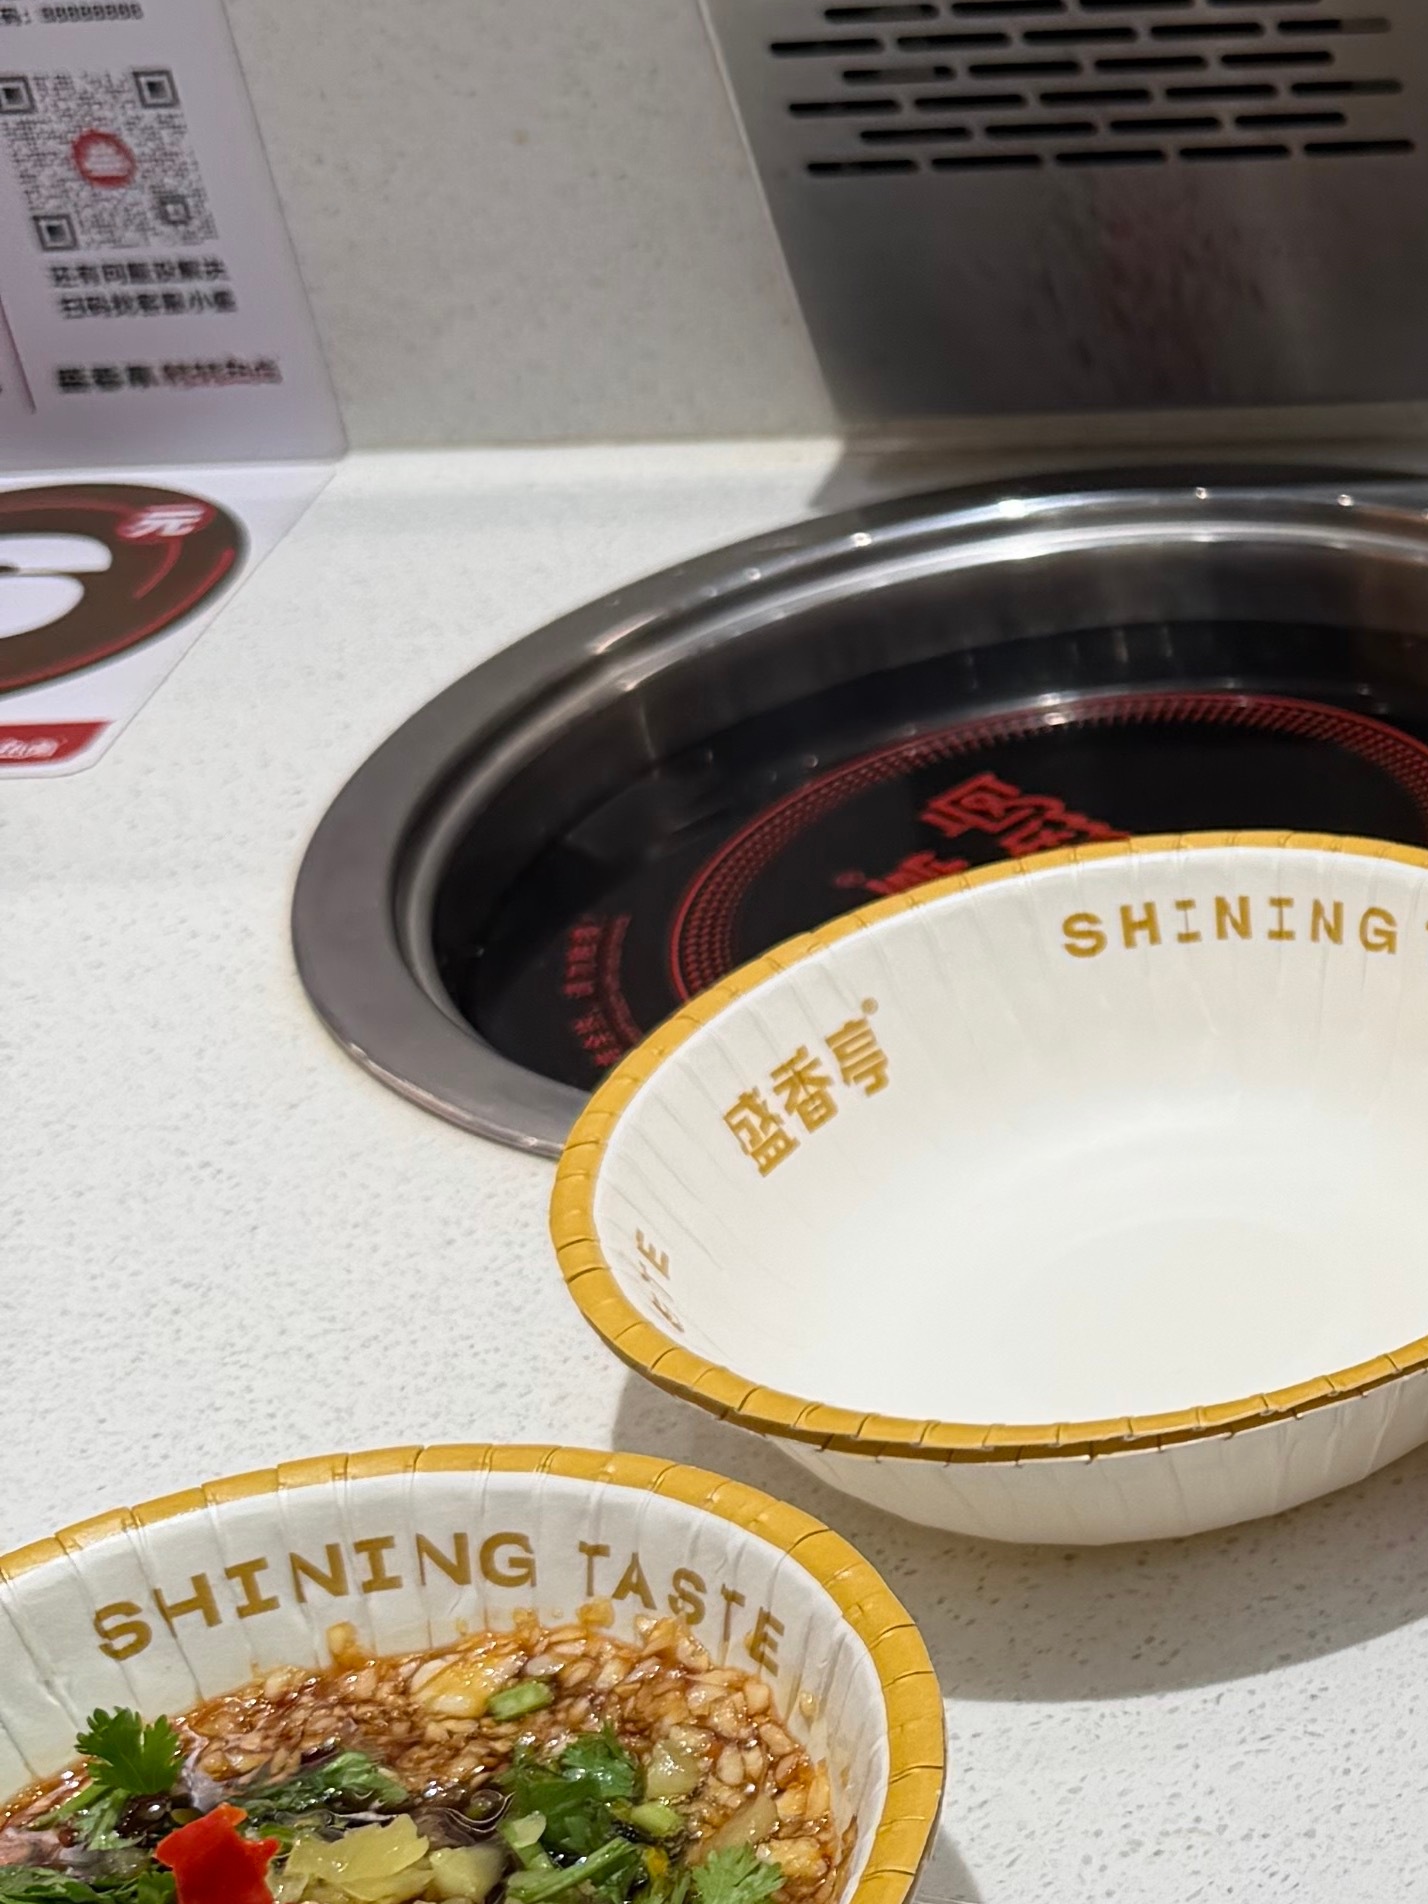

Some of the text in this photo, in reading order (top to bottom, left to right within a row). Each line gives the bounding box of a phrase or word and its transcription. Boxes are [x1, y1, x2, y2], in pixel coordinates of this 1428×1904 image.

[1060, 896, 1400, 959] SHINING
[720, 1013, 893, 1177] 盛香亭
[94, 1532, 785, 1676] SHINING TASTE
